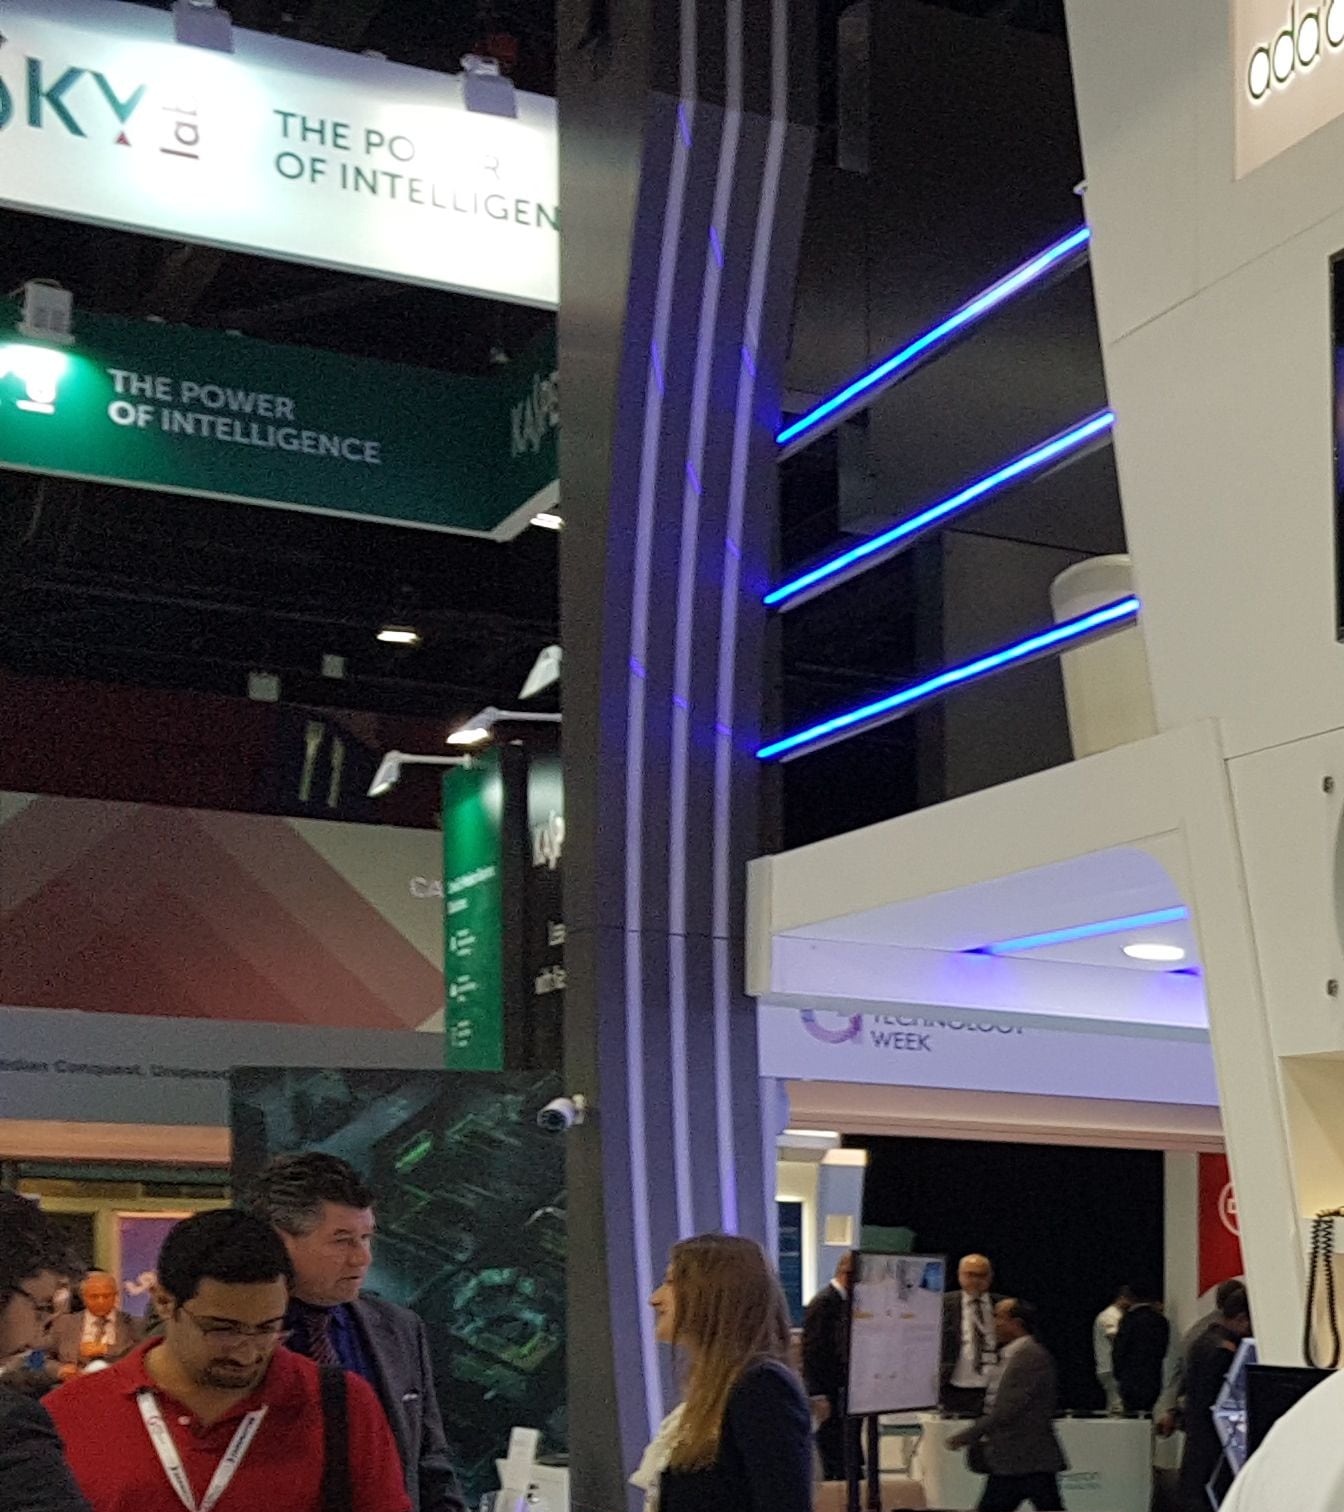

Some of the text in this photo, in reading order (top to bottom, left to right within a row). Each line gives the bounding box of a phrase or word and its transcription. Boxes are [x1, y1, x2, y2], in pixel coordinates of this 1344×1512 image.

[274, 109, 501, 181] THE POR
[275, 153, 326, 184] OF
[107, 368, 297, 421] THE POWER
[107, 400, 382, 465] OF INTELLIGENCE
[870, 1029, 932, 1052] WEEK
